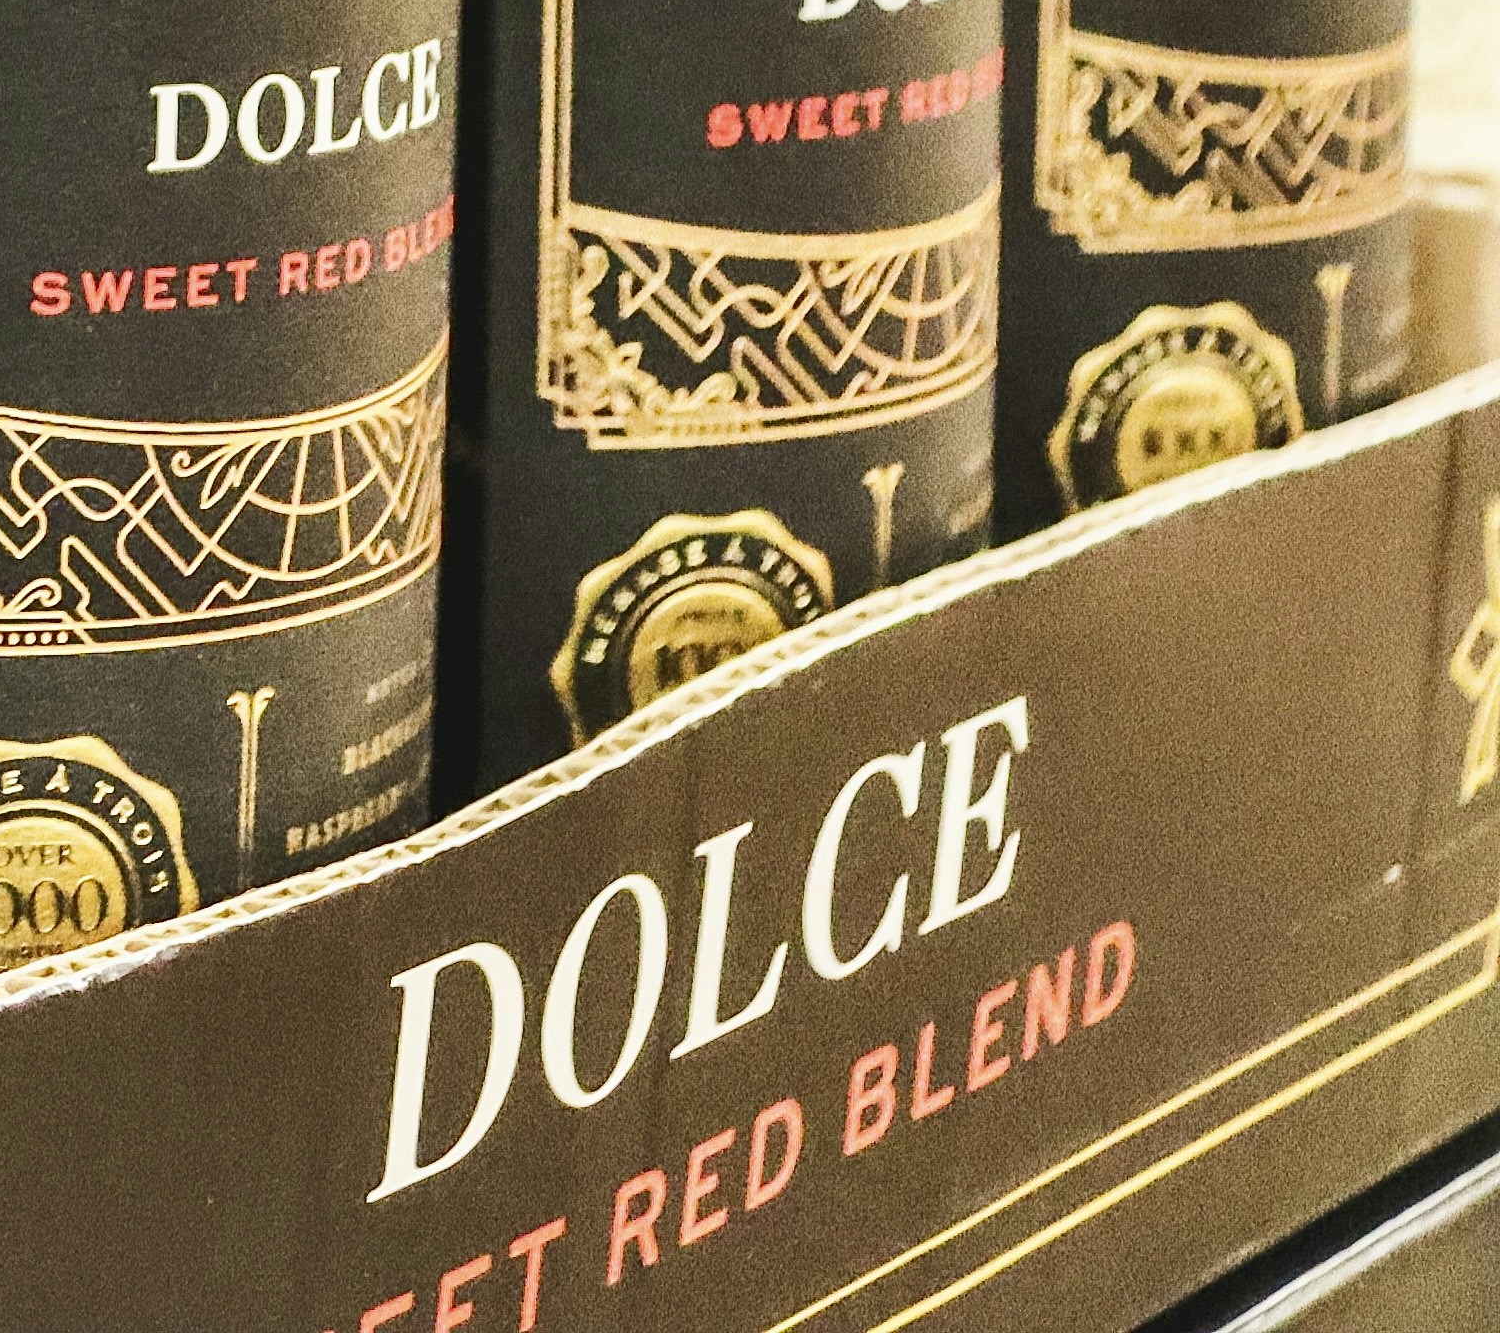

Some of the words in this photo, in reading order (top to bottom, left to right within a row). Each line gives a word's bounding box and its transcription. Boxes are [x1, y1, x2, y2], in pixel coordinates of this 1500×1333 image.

[148, 38, 442, 174] DOLCE
[706, 87, 890, 149] SWEET
[30, 257, 257, 317] SWEET
[279, 237, 372, 296] RED
[365, 695, 1032, 1204] DOLCE
[605, 1096, 805, 1287] RED
[841, 920, 1137, 1159] BLEND
